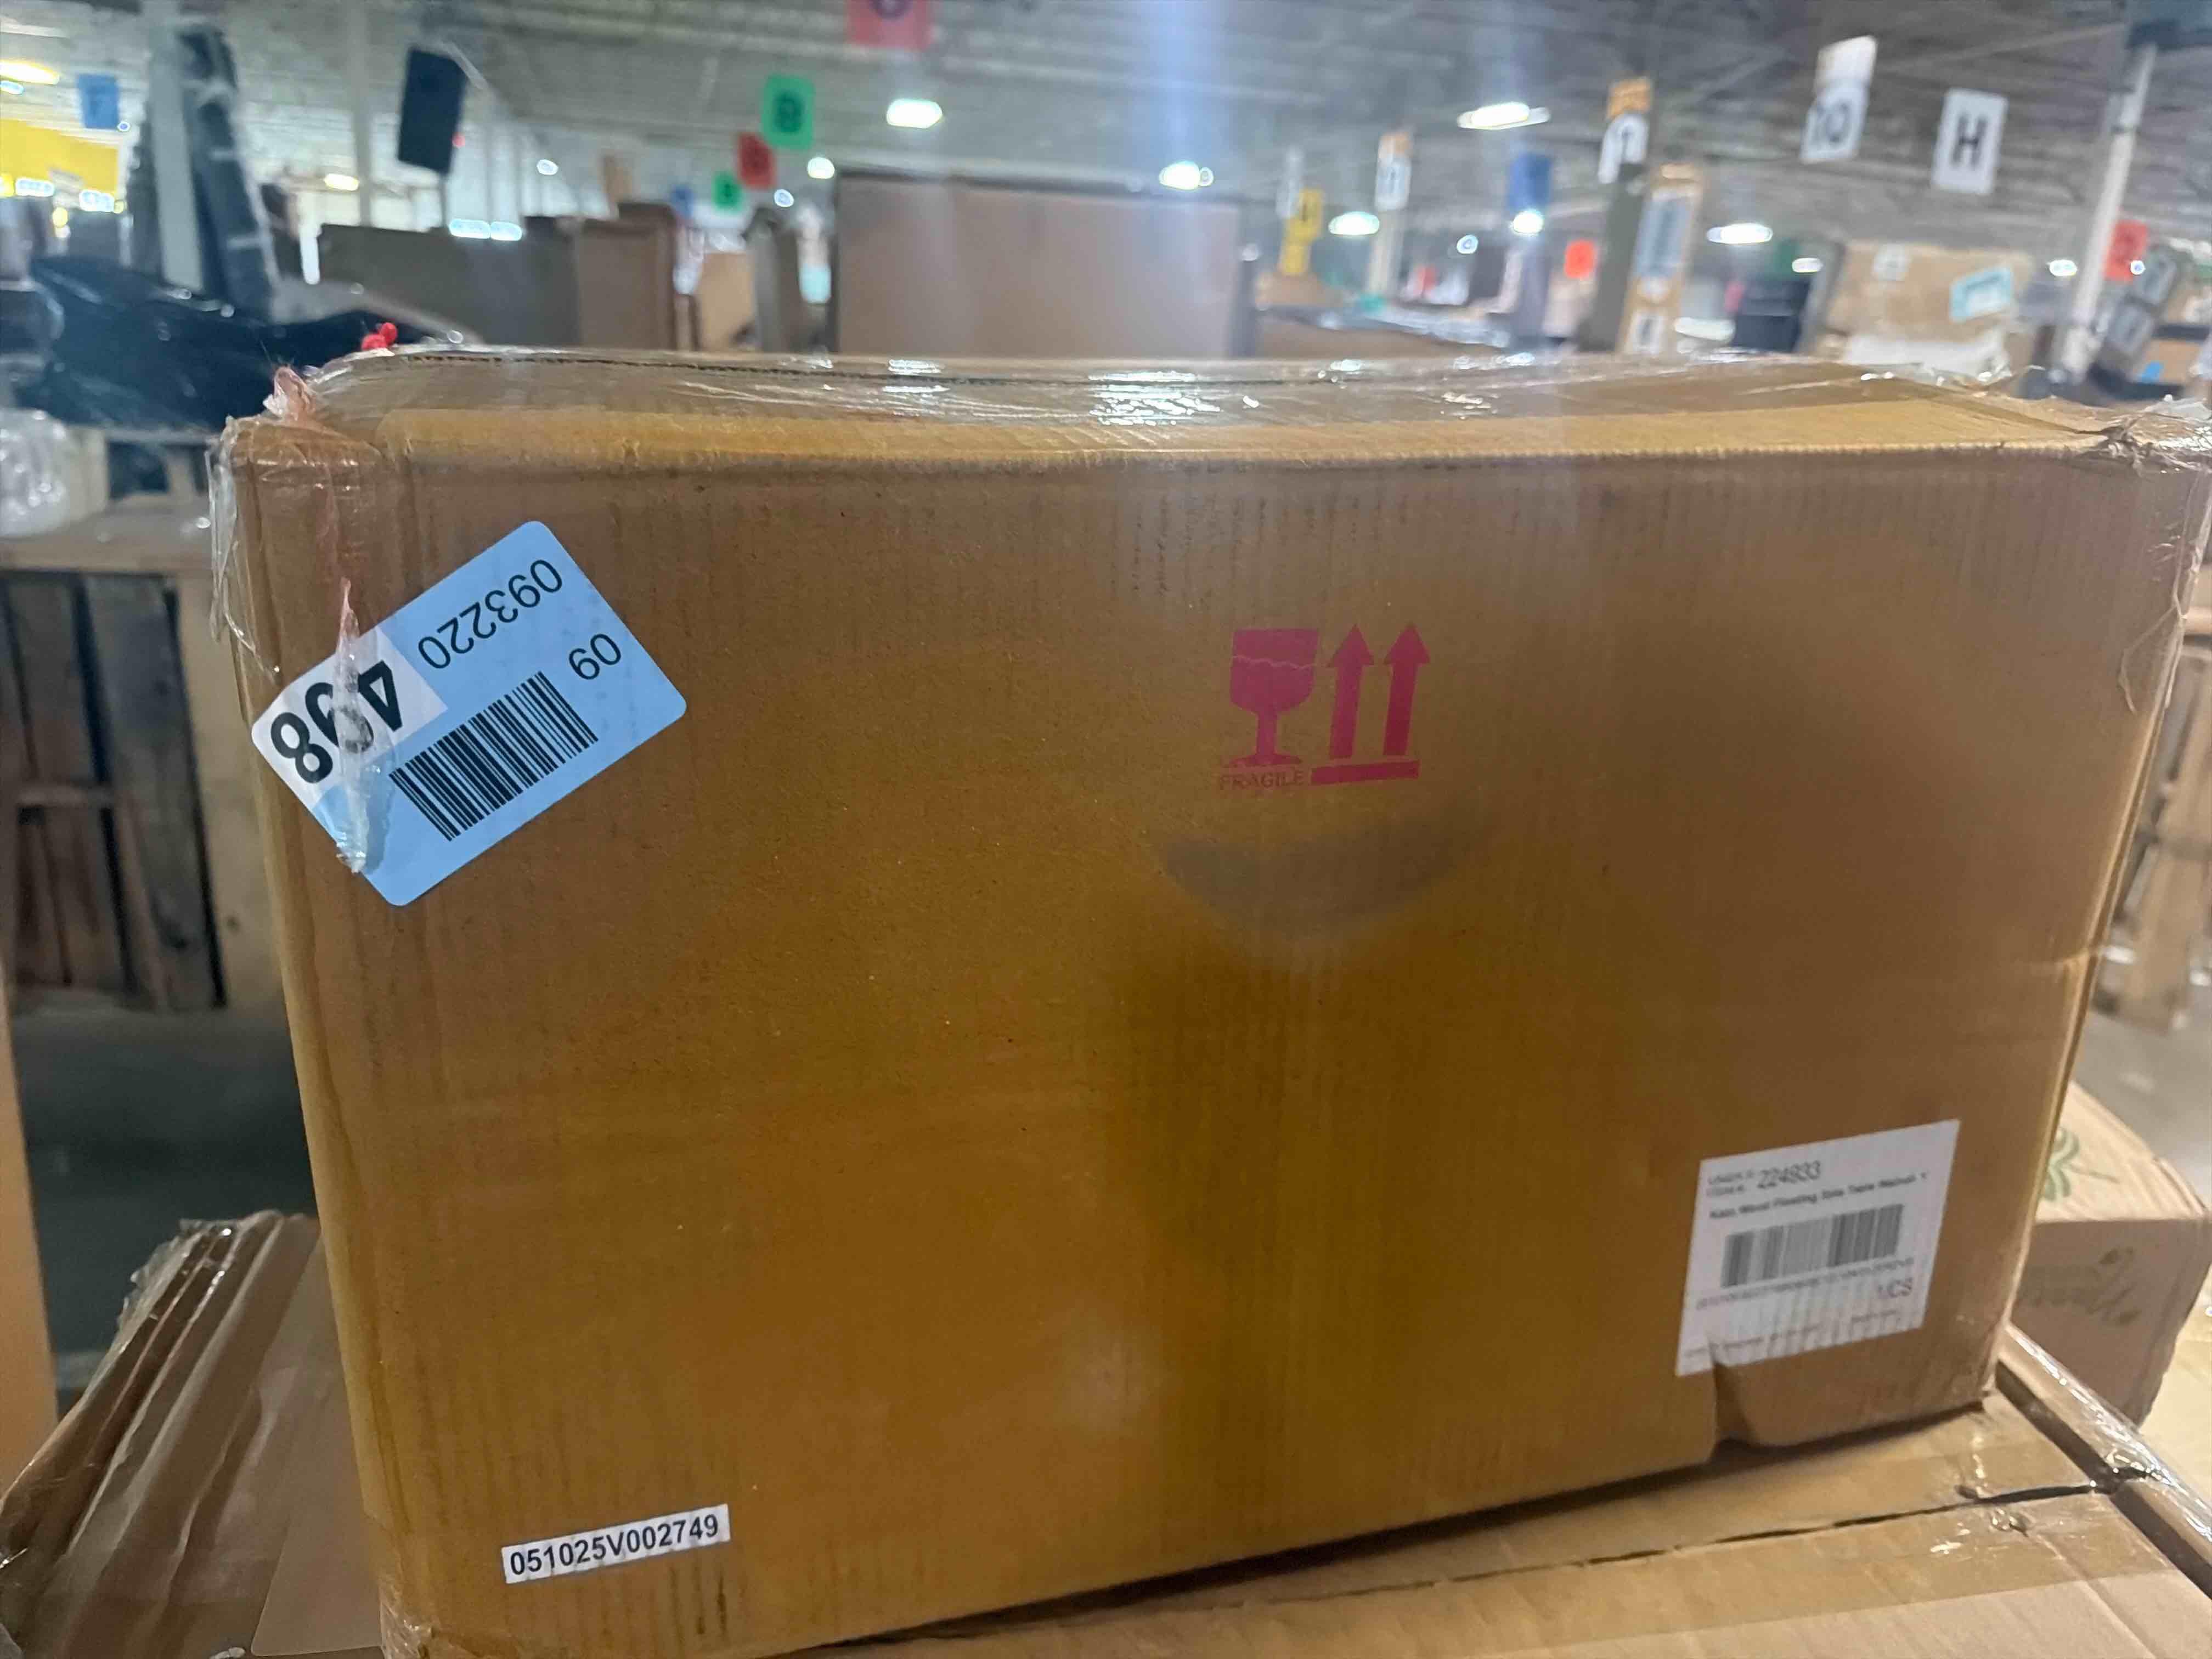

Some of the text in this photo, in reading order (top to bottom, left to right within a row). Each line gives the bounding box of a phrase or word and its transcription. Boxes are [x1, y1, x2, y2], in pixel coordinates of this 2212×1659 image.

[1951, 114, 1988, 167] H
[418, 559, 562, 669] 093220
[568, 633, 621, 680] 09
[1220, 770, 1304, 791] FRAGILE
[510, 1513, 719, 1575] 051025V002749
